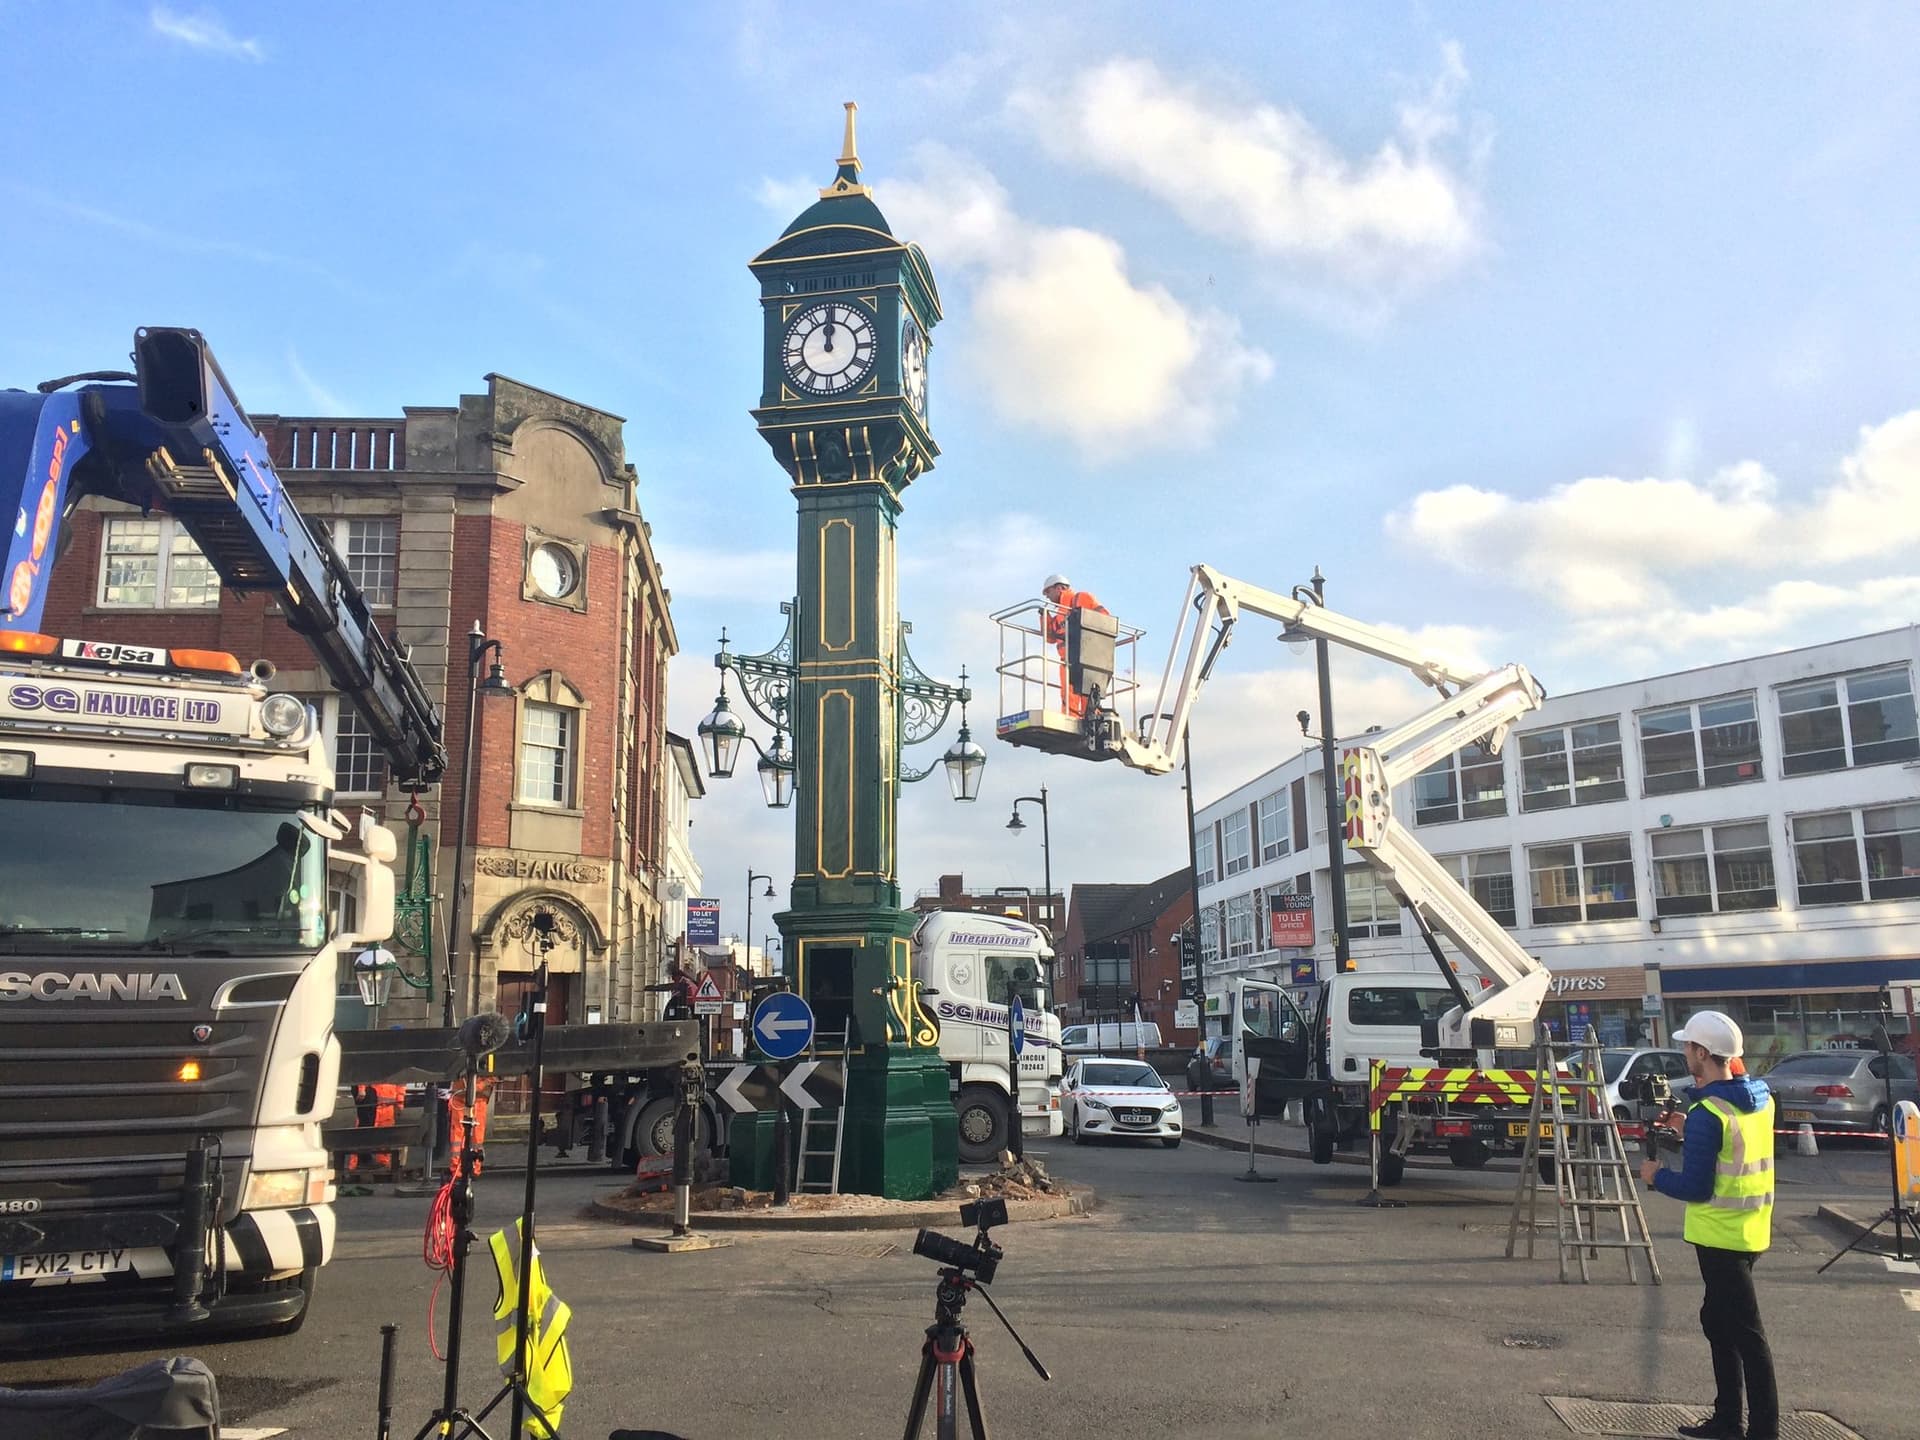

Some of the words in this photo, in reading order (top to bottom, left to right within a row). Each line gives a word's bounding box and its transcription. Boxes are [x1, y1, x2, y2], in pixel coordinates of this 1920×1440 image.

[75, 641, 155, 664] Kelsa
[9, 684, 80, 713] SG
[84, 690, 180, 722] HAULAGE
[183, 697, 221, 725] LTD
[514, 861, 576, 884] BANK
[1277, 913, 1289, 922] TO
[1290, 912, 1307, 922] LET
[948, 931, 1033, 948] International
[0, 972, 188, 1001] SCANIA
[938, 1000, 975, 1021] SG
[975, 1005, 1010, 1026] HAULA
[1024, 1015, 1043, 1033] LTD
[19, 1253, 70, 1275] FX12
[80, 1248, 125, 1271] CTY
